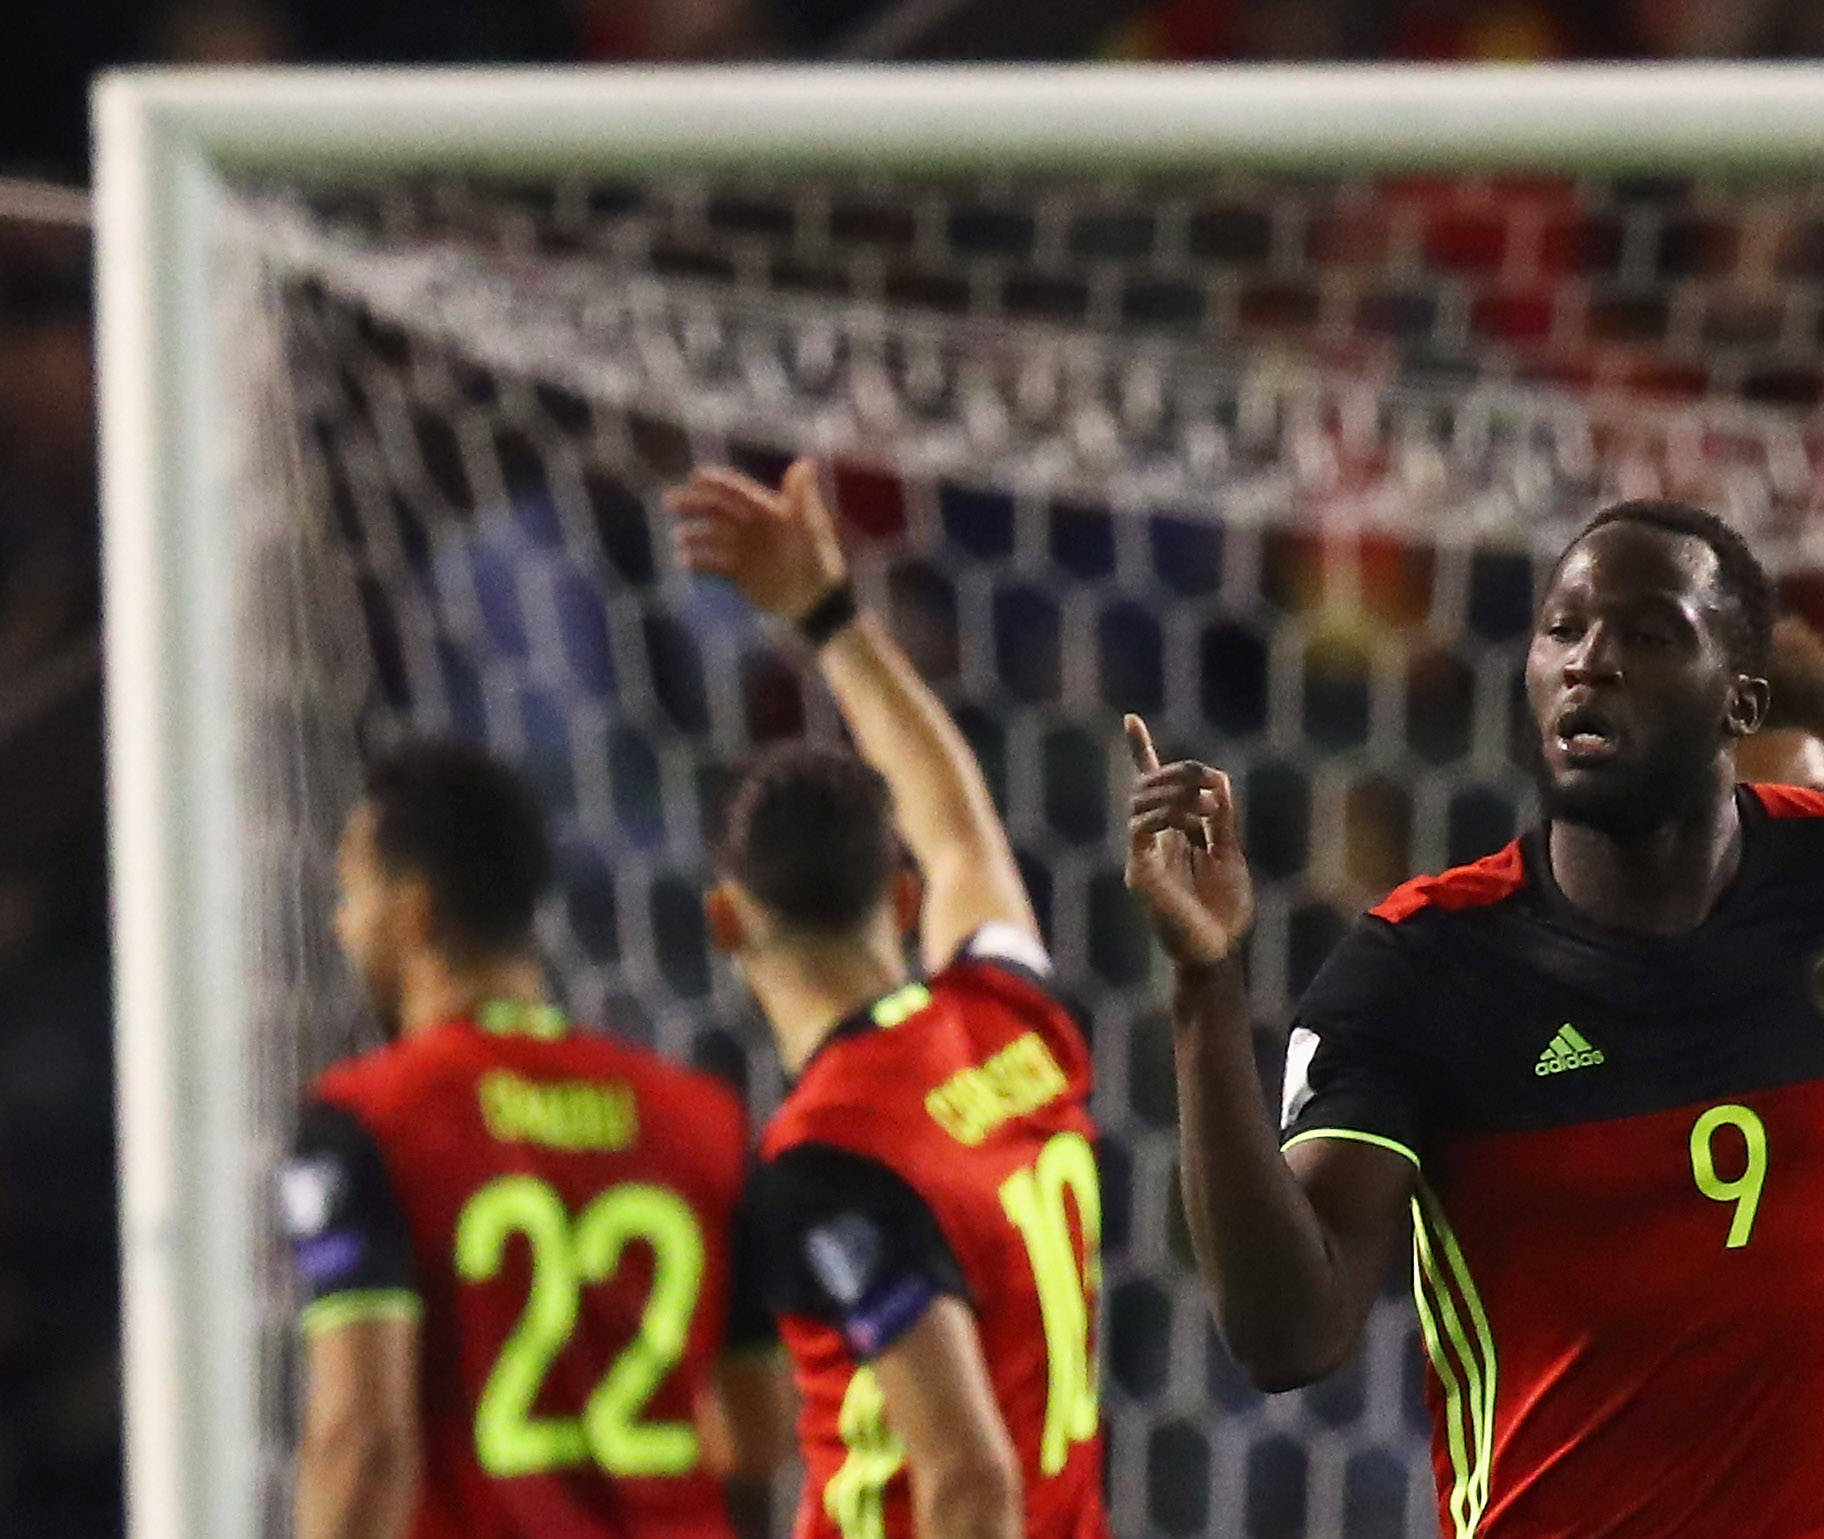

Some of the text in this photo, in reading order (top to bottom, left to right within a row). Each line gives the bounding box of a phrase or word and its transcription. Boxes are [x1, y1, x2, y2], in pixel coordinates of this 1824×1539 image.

[1534, 1049, 1606, 1077] adidas
[1689, 1103, 1769, 1249] 9
[454, 1176, 706, 1477] 22
[998, 1131, 1105, 1475] 10
